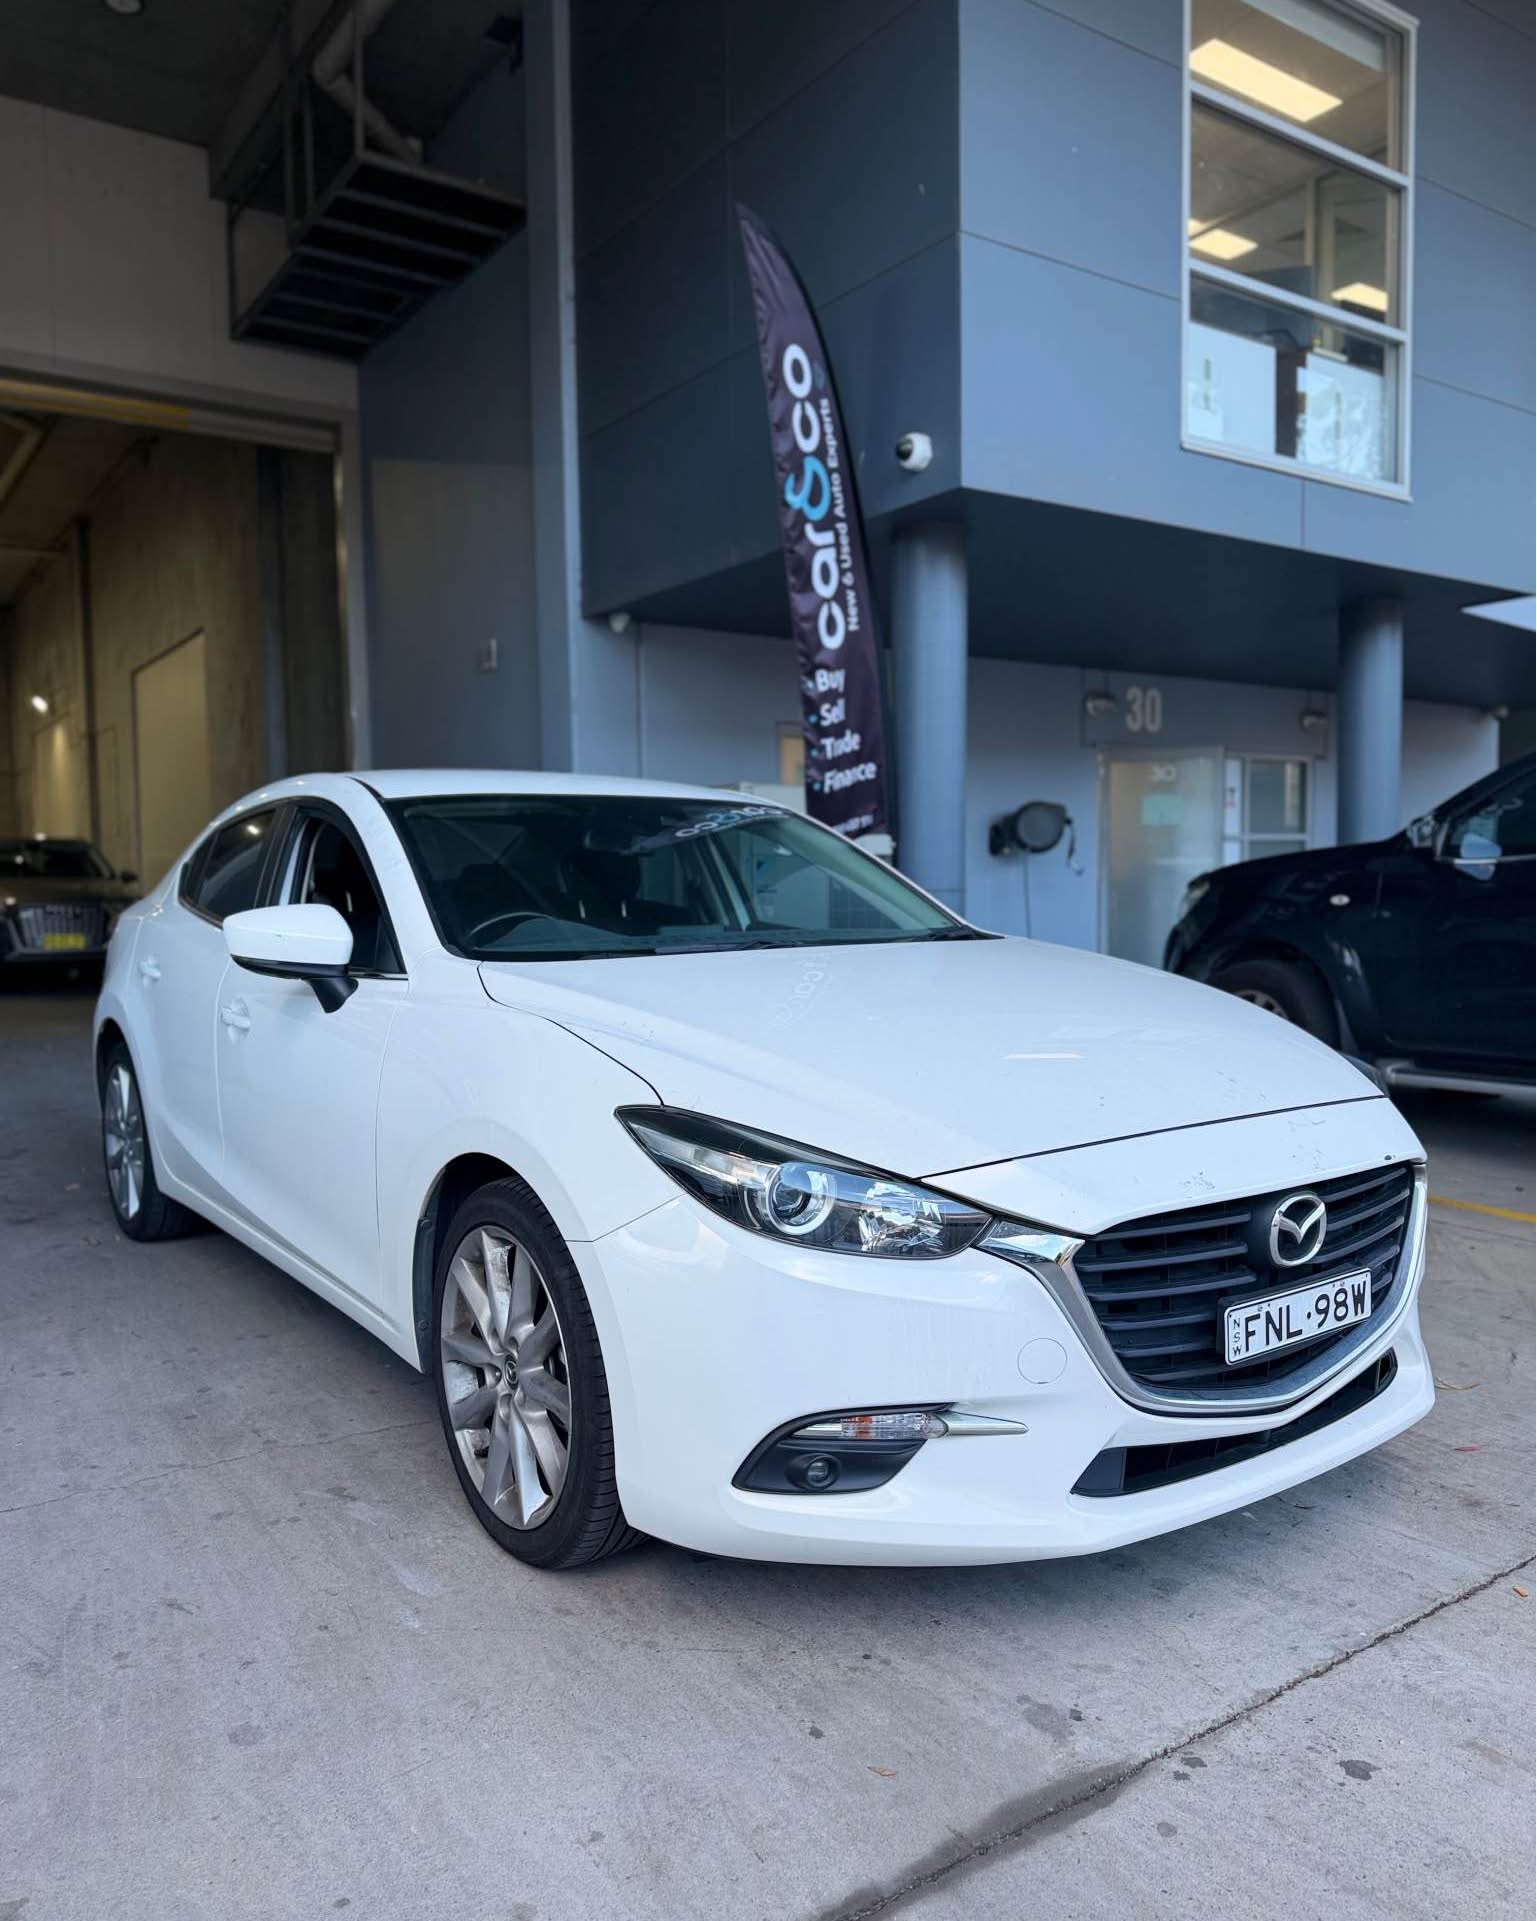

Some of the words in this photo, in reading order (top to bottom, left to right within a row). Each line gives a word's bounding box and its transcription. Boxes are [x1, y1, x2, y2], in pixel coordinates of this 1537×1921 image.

[820, 398, 839, 468] Experts
[831, 472, 847, 519] Auto
[836, 522, 852, 568] Used
[841, 571, 855, 587] &
[847, 589, 860, 632] New
[815, 669, 845, 692] Buy
[1125, 686, 1163, 733] 30
